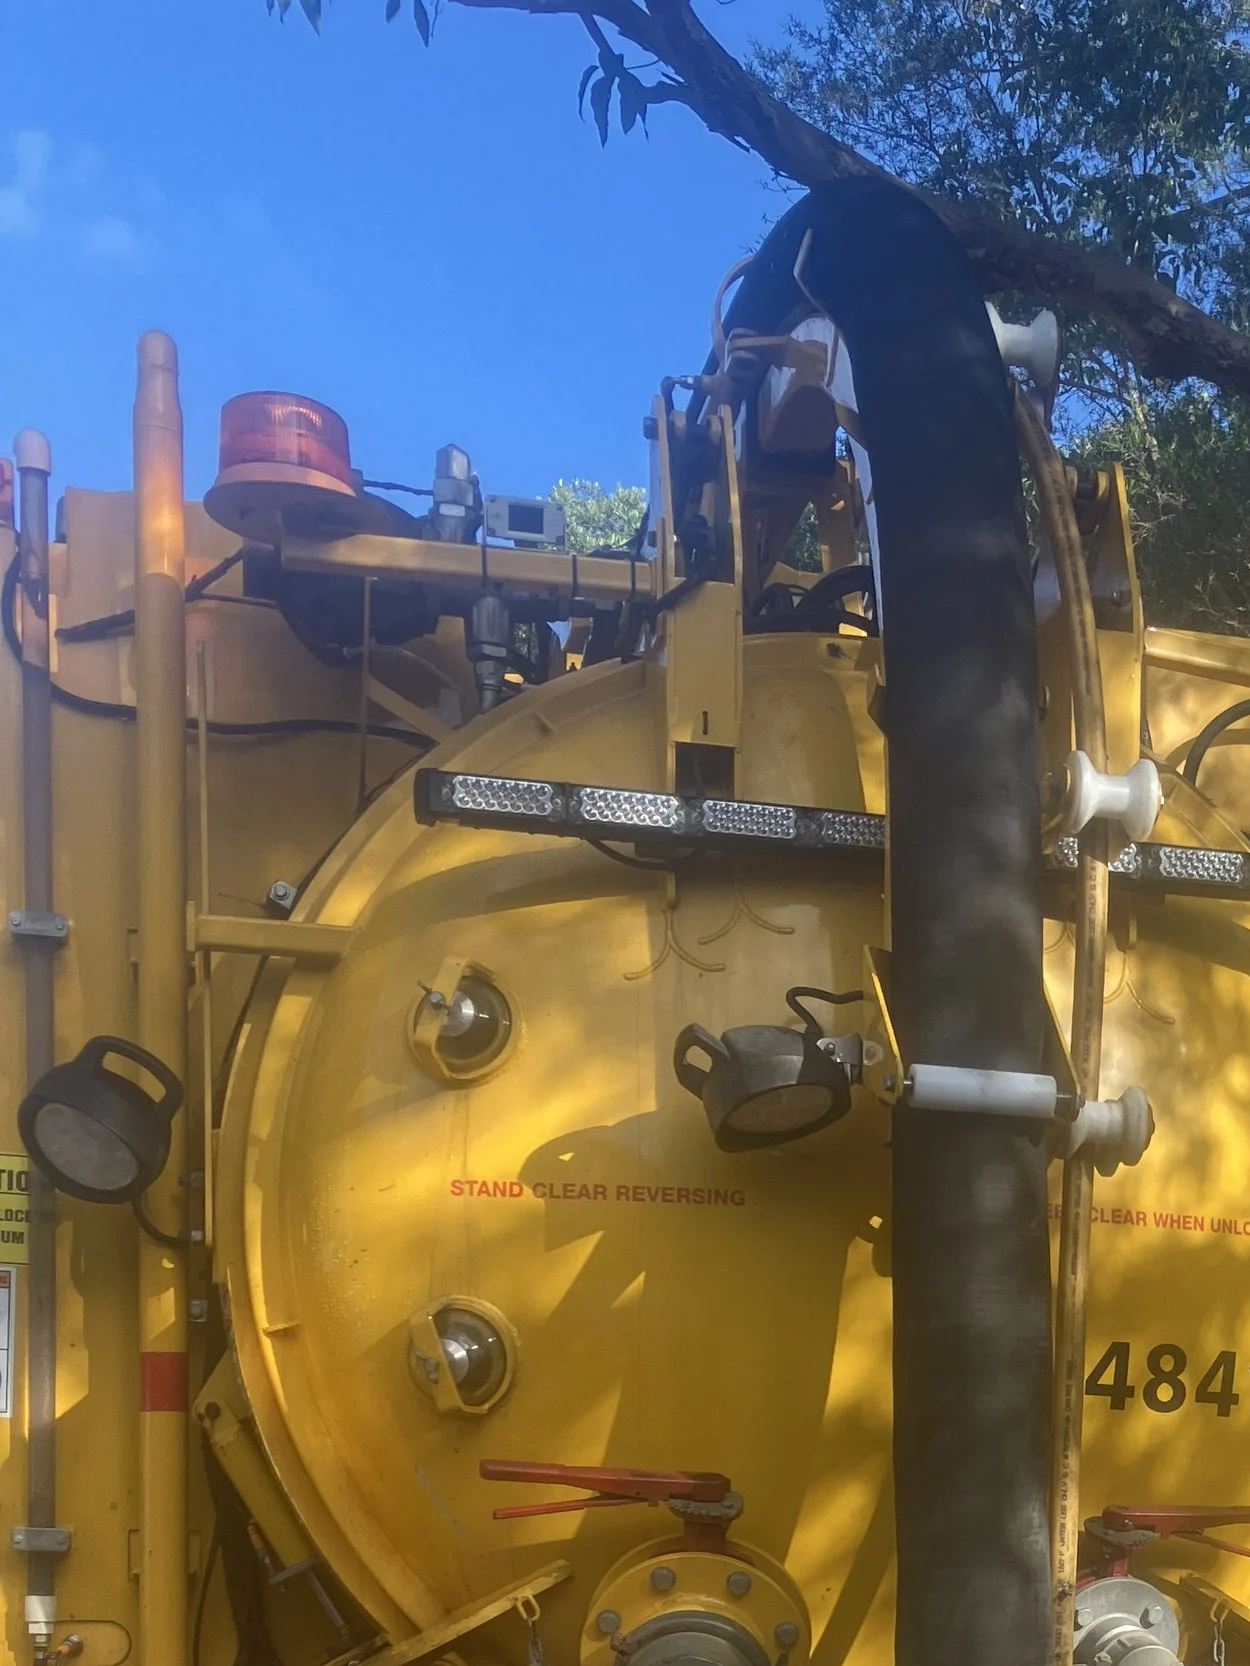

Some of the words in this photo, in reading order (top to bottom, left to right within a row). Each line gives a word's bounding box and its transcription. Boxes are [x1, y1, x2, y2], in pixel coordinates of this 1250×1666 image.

[450, 1179, 523, 1198] STAND
[532, 1182, 607, 1201] CLEAR
[616, 1185, 746, 1206] REVERSING
[1090, 1207, 1148, 1227] CLEAR
[1153, 1212, 1204, 1232] WHEN
